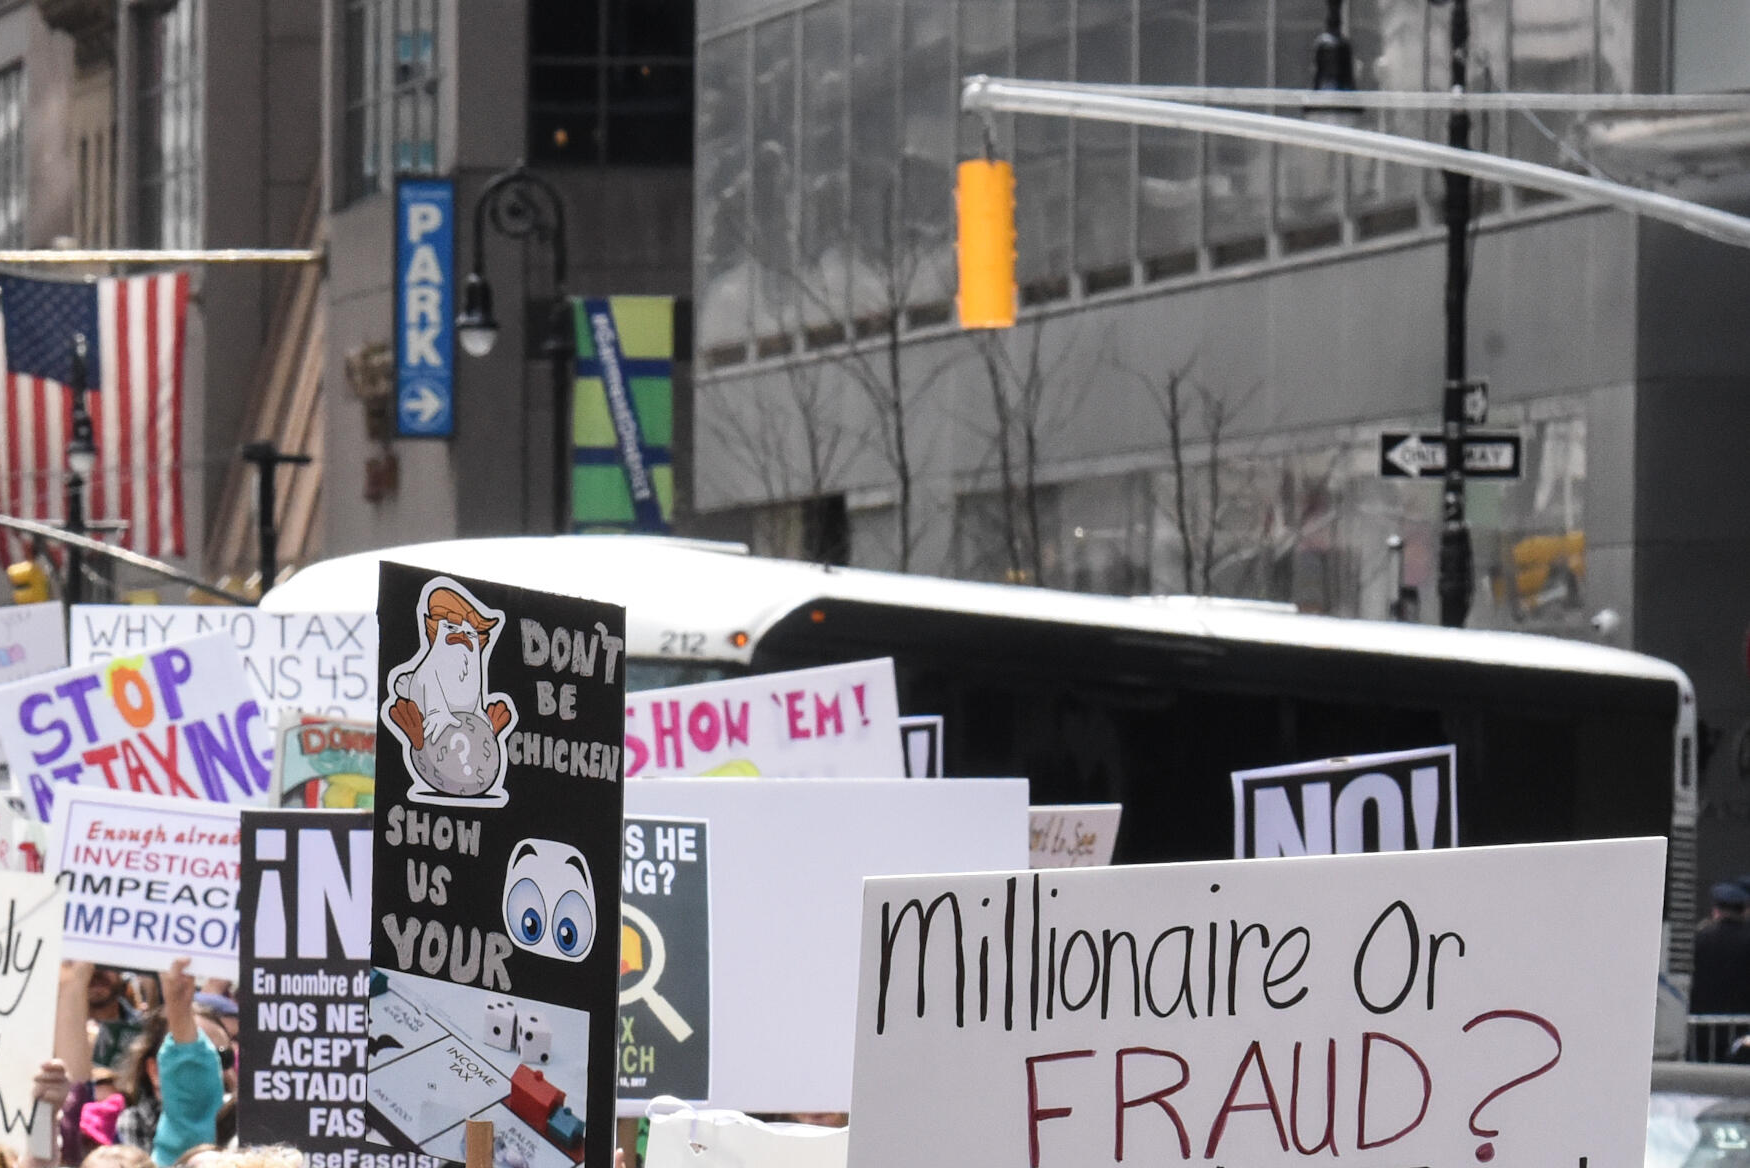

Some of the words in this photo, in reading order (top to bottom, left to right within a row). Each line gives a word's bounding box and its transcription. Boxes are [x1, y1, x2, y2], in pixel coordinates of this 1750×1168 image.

[406, 203, 444, 368] PARK
[84, 613, 175, 648] WHY
[196, 612, 256, 650] NO
[272, 613, 367, 651] TAX
[519, 617, 624, 685] DON'T
[659, 630, 708, 656] 212
[18, 647, 193, 767] STOP
[536, 680, 578, 721] BE
[625, 698, 750, 778] SHOW
[507, 734, 621, 784] CHICKEN
[86, 821, 168, 849] Enough
[384, 803, 482, 858] SHOW
[656, 826, 698, 862] HE
[73, 844, 241, 882] INVESTIGAT
[406, 857, 452, 906] US
[65, 869, 241, 911] IMPEAC
[381, 911, 516, 994] YOUR
[876, 872, 1312, 1036] Millionaire
[1353, 899, 1465, 1014] Or
[253, 967, 276, 995] En
[280, 968, 343, 997] nombre
[257, 1002, 318, 1032] NOS
[325, 1003, 369, 1033] NE
[270, 1037, 369, 1068] ACEPT
[447, 1047, 498, 1088] INCOME
[253, 1071, 367, 1101] ESTADO
[448, 1063, 475, 1084] TAX
[308, 1107, 365, 1138] FAS
